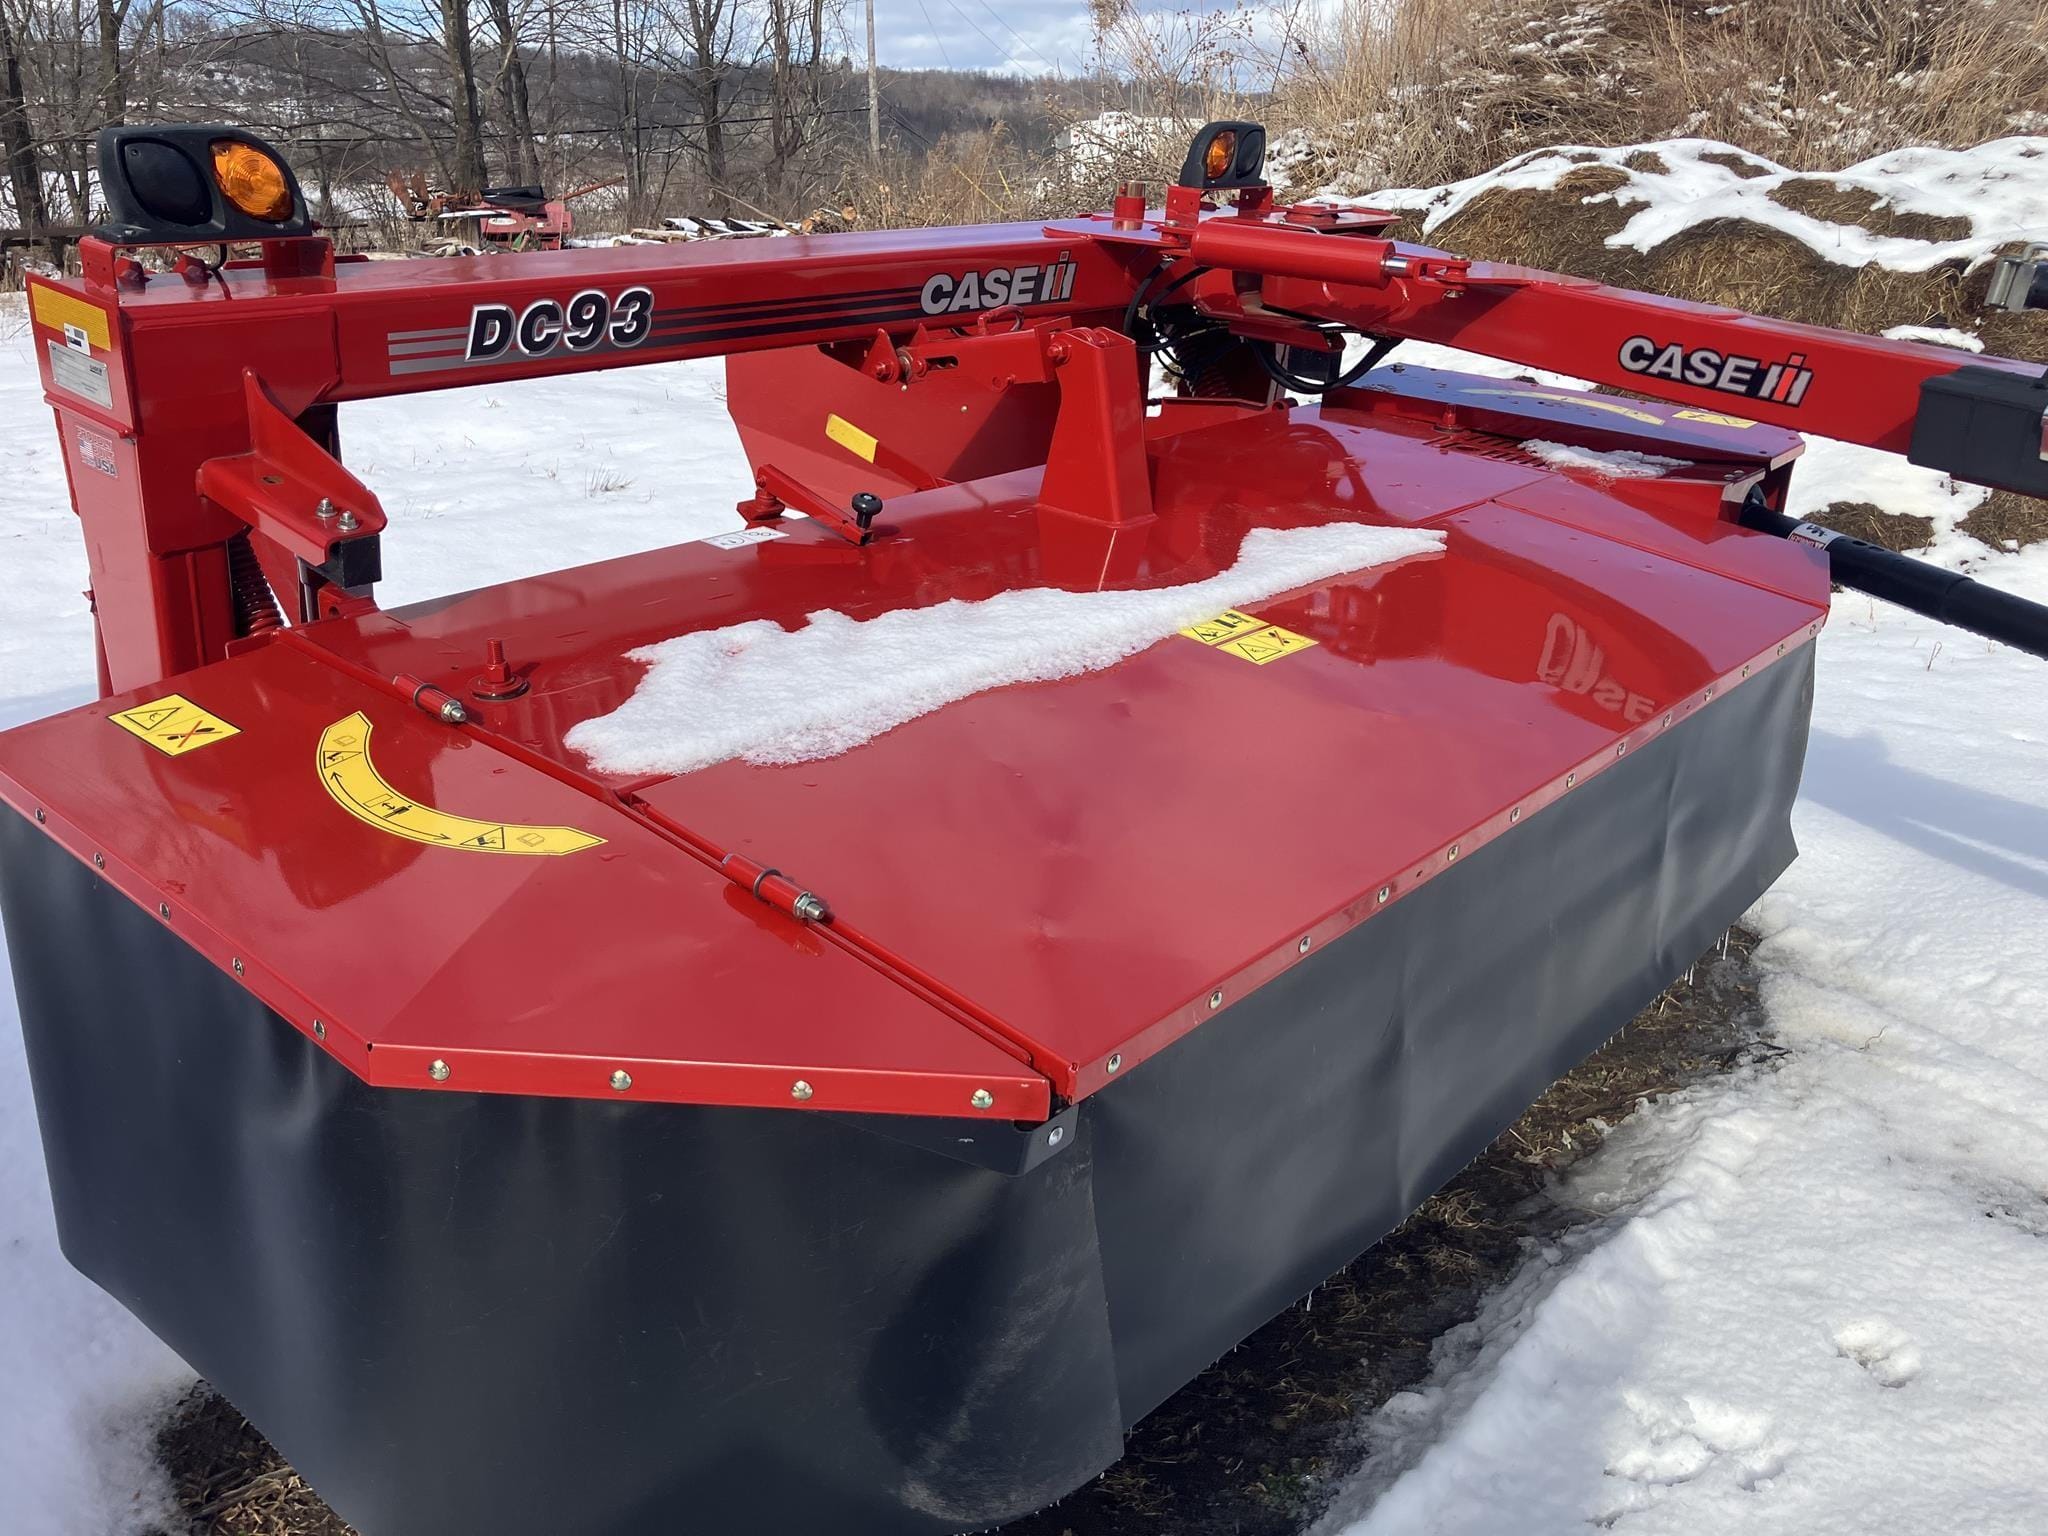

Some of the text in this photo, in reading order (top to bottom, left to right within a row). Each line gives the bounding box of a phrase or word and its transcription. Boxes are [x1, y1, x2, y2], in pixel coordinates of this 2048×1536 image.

[920, 266, 1040, 315] CASE
[465, 286, 655, 362] DC93
[1618, 335, 1760, 393] CASE
